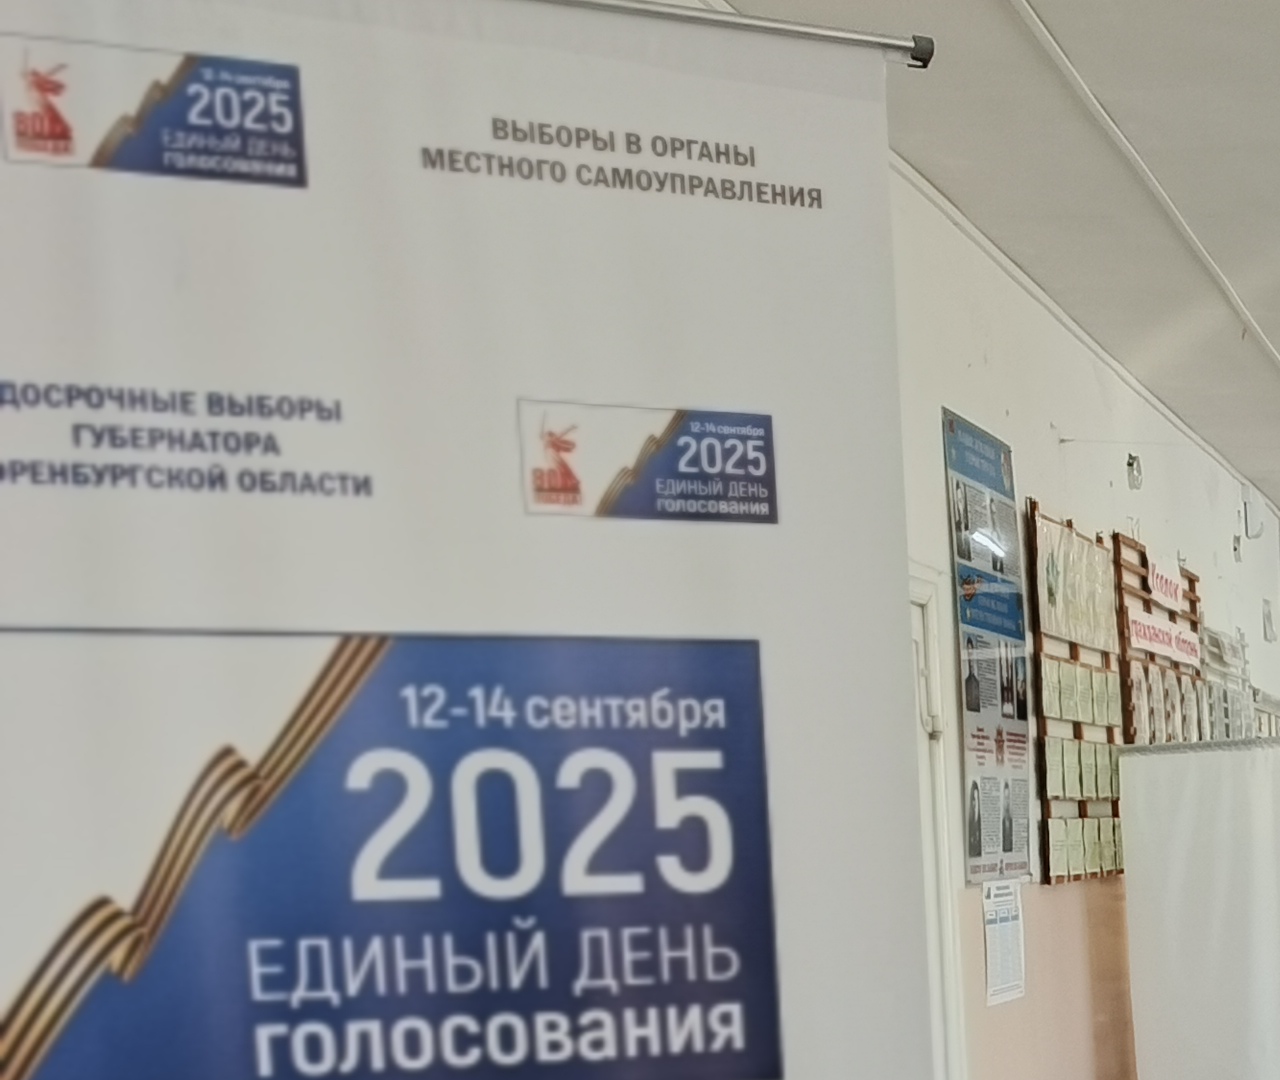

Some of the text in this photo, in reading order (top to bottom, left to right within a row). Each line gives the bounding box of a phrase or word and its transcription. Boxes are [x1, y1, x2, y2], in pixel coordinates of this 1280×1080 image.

[187, 83, 293, 133] 2025
[491, 117, 756, 168] ВЫБОРЫ В ОРГАНЫ
[420, 147, 823, 209] МЕСТНОГО САМОУПРАВЛЕНИЯ
[0, 380, 343, 423] ДОСРОЧНЫЕ ВЫБОРЫ
[71, 423, 281, 456] ГУБЕРНАТОРА
[717, 424, 765, 438] сентября
[677, 436, 767, 476] 2025
[236, 470, 373, 498] ОБЛАСТИ
[656, 477, 768, 498] ЕДИНЫЙ ДЕНЬ
[657, 498, 769, 515] голосования
[402, 685, 727, 737] 12-14 сентября
[345, 748, 733, 900] 2025
[248, 917, 741, 1008] ЕДИНЫЙ ДЕНЬ
[253, 1003, 745, 1077] голосования
